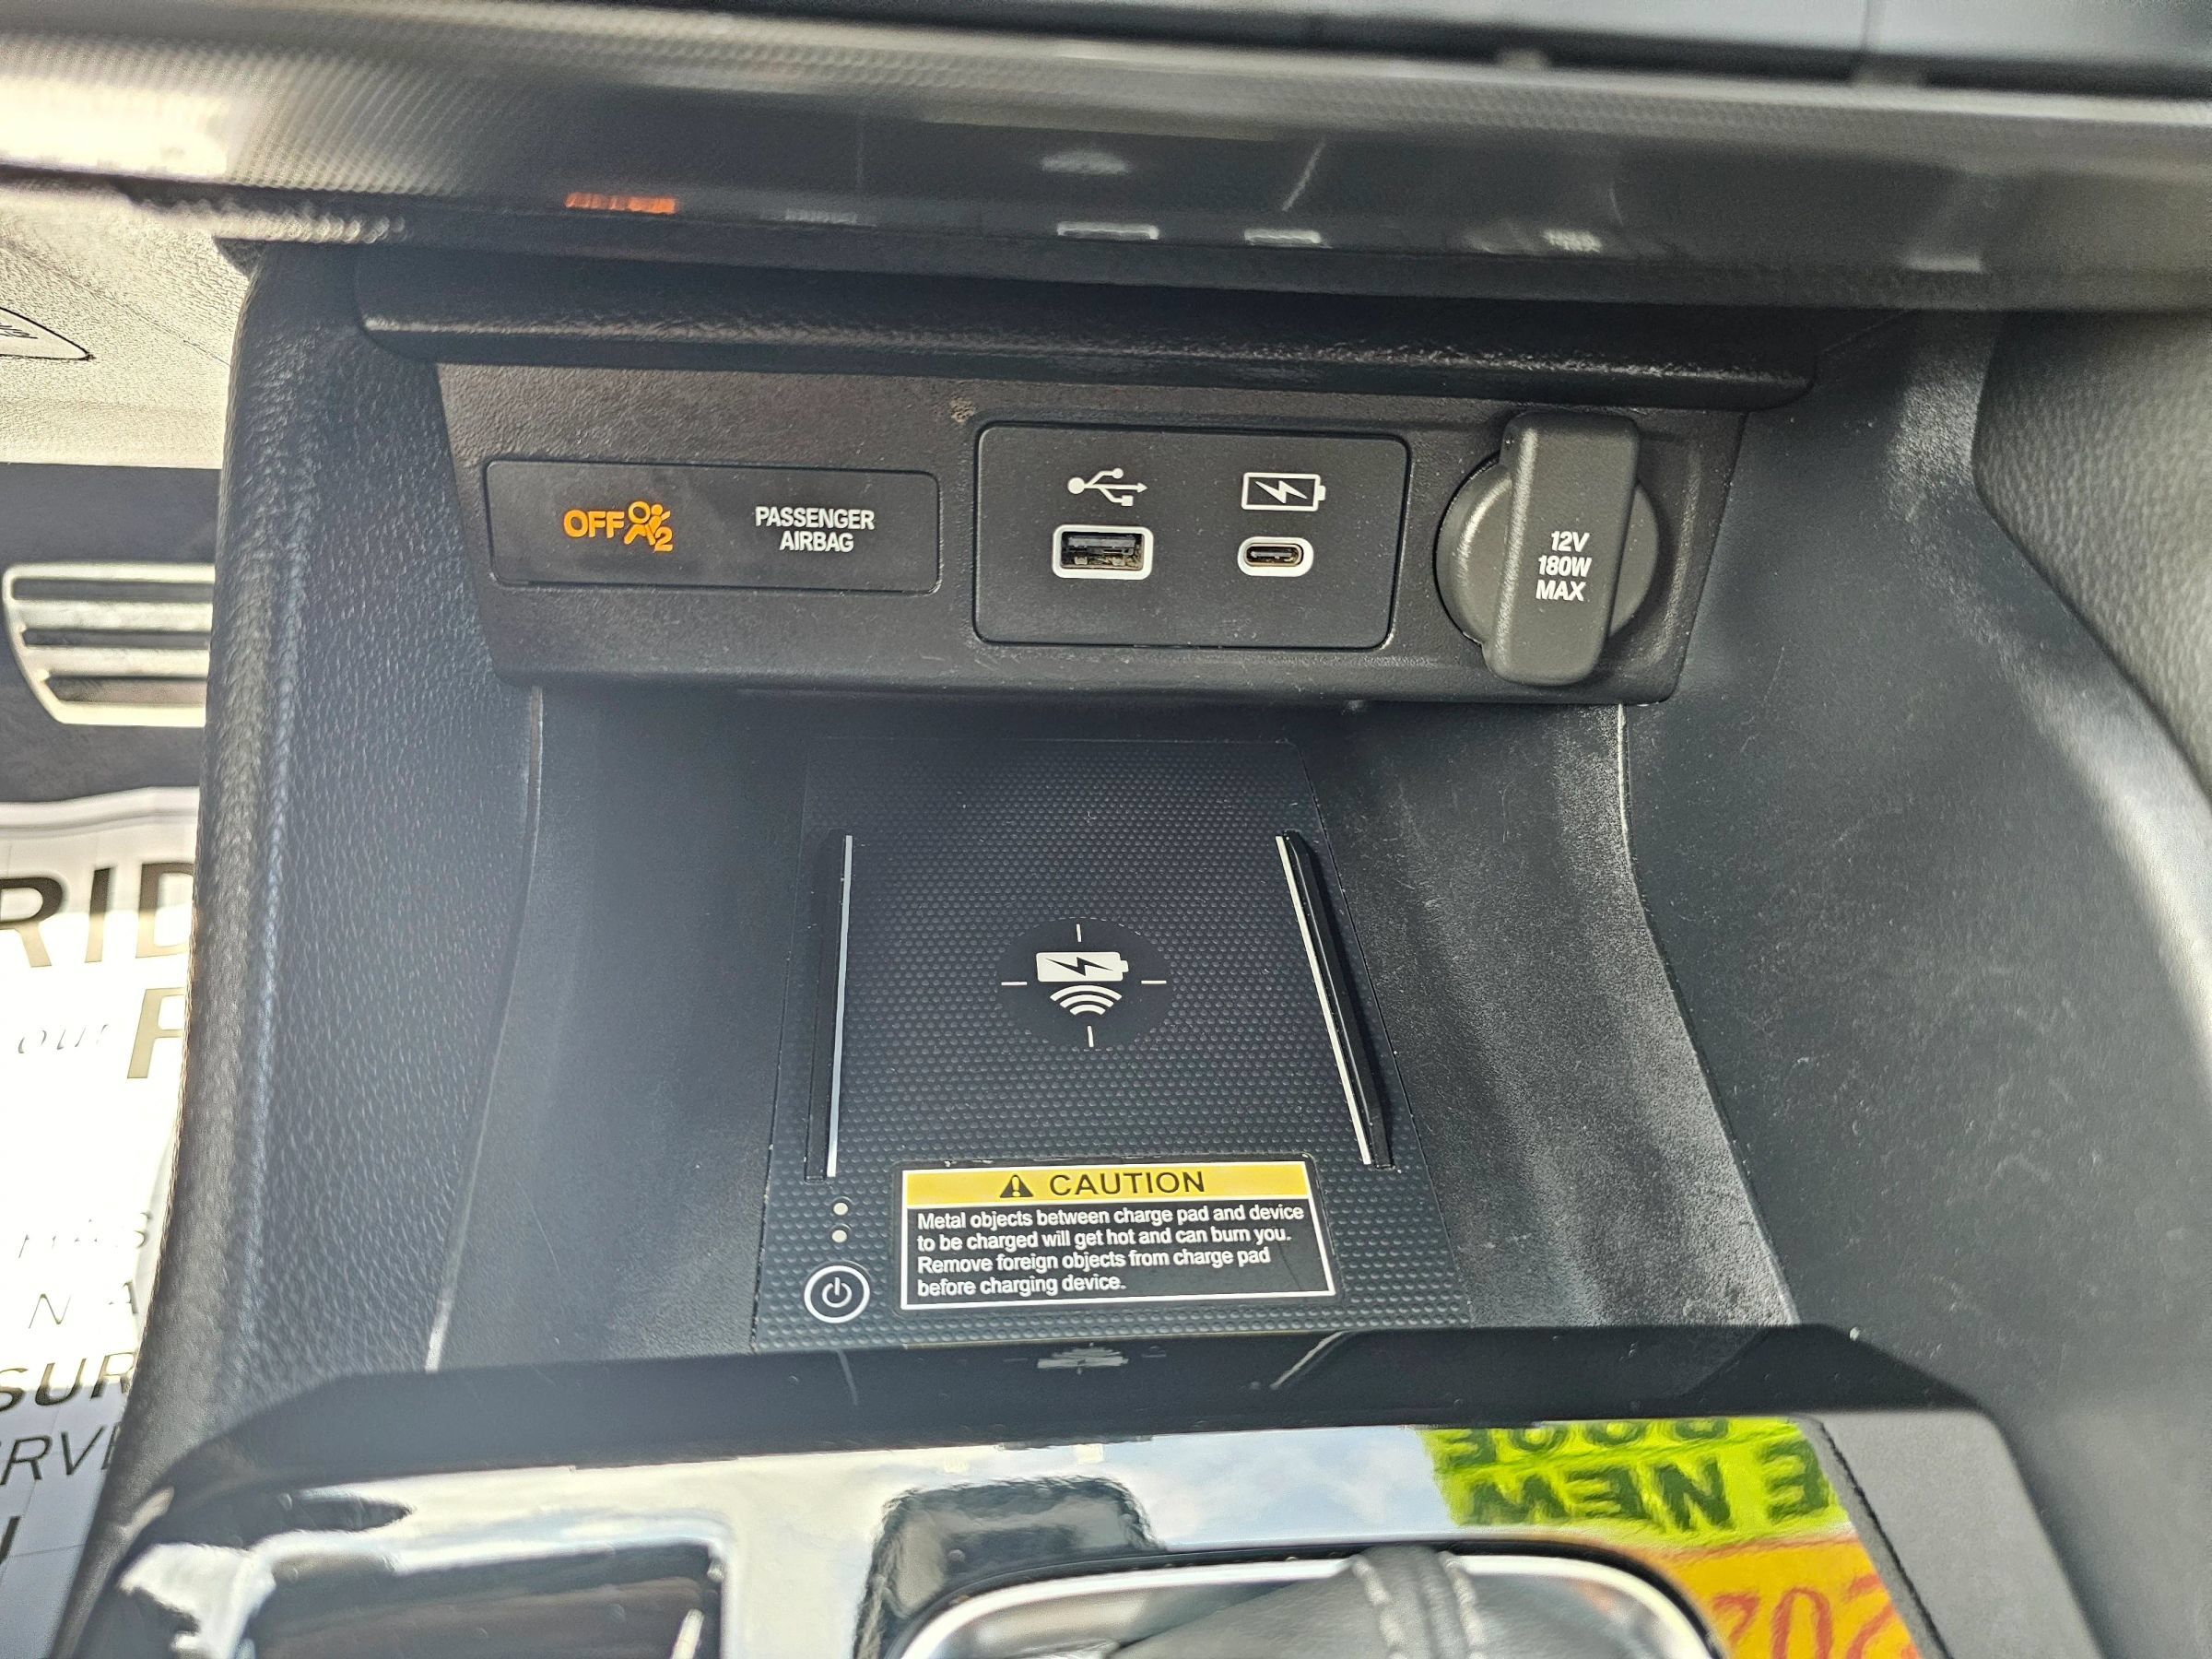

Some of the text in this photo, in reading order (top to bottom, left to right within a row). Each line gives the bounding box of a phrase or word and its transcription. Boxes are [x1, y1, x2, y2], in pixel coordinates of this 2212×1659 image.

[563, 509, 625, 538] OFF
[755, 505, 876, 530] PASSENGER
[779, 530, 854, 553] AIRBAG
[1550, 530, 1591, 552] 12V
[1537, 555, 1593, 578] 180W
[1535, 580, 1587, 602] MAX
[1049, 1171, 1206, 1196] CAUTION
[917, 1203, 1305, 1231] Metal objects between charge pad and device
[916, 1225, 1292, 1253] to be charged will get hot and can burn you.
[917, 1245, 1272, 1274] Remove foreign objects from charge pad
[917, 1273, 1127, 1297] before charging device.
